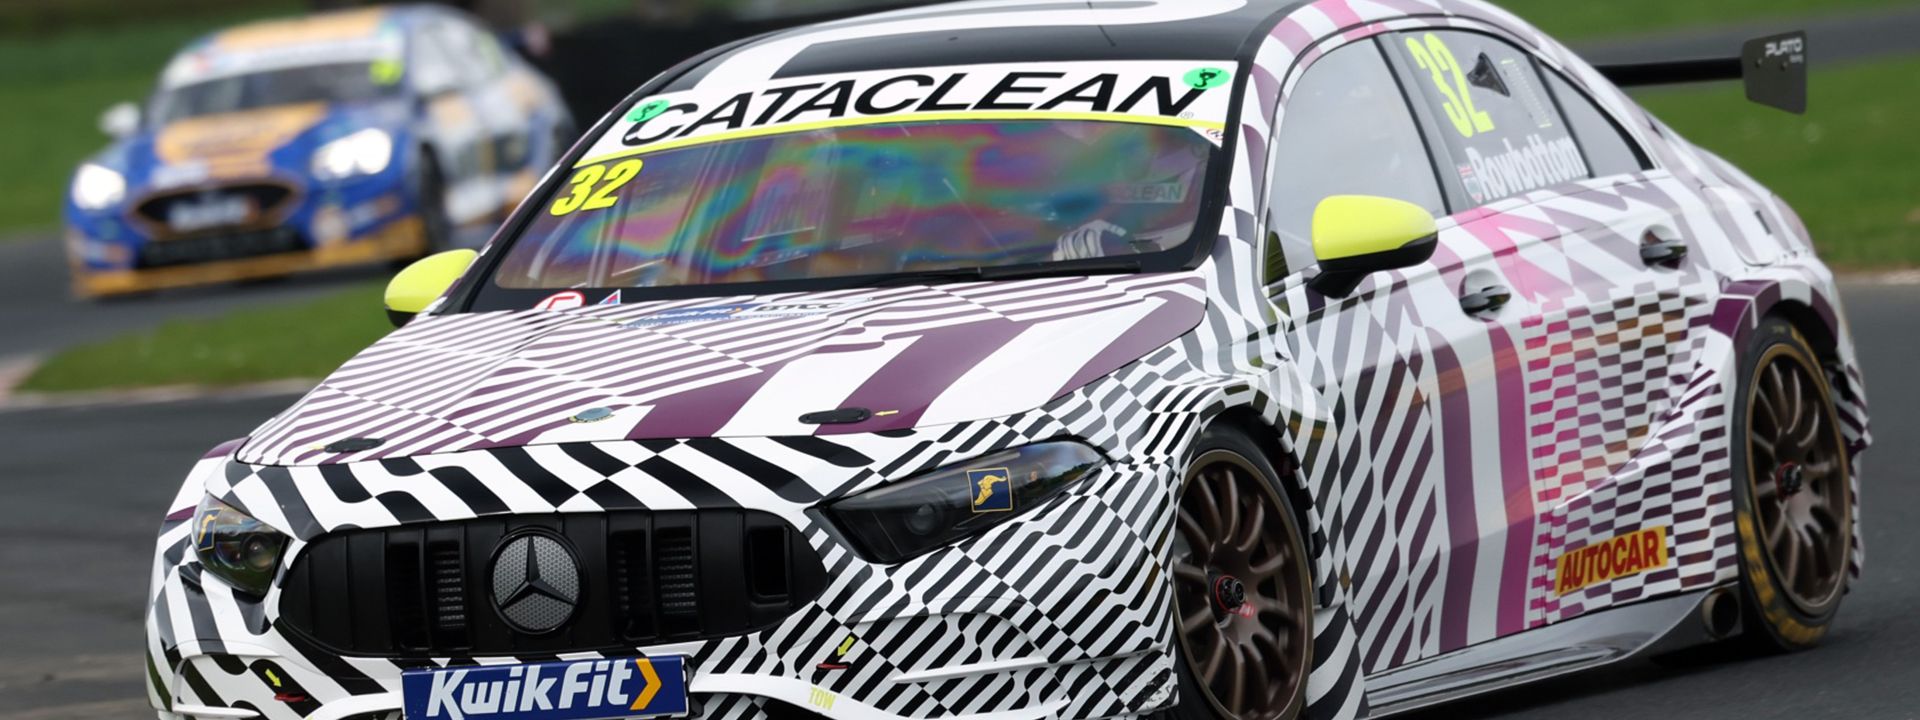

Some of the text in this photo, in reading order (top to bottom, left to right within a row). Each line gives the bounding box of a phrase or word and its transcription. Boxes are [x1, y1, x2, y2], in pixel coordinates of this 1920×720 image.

[1764, 37, 1803, 57] PLATO
[621, 71, 1208, 147] CATACLEAN
[1405, 32, 1495, 138] 32
[549, 158, 644, 216] 32
[1465, 133, 1589, 200] Rowbottom
[1559, 529, 1662, 593] AUTOCAR
[808, 686, 837, 711] TOW
